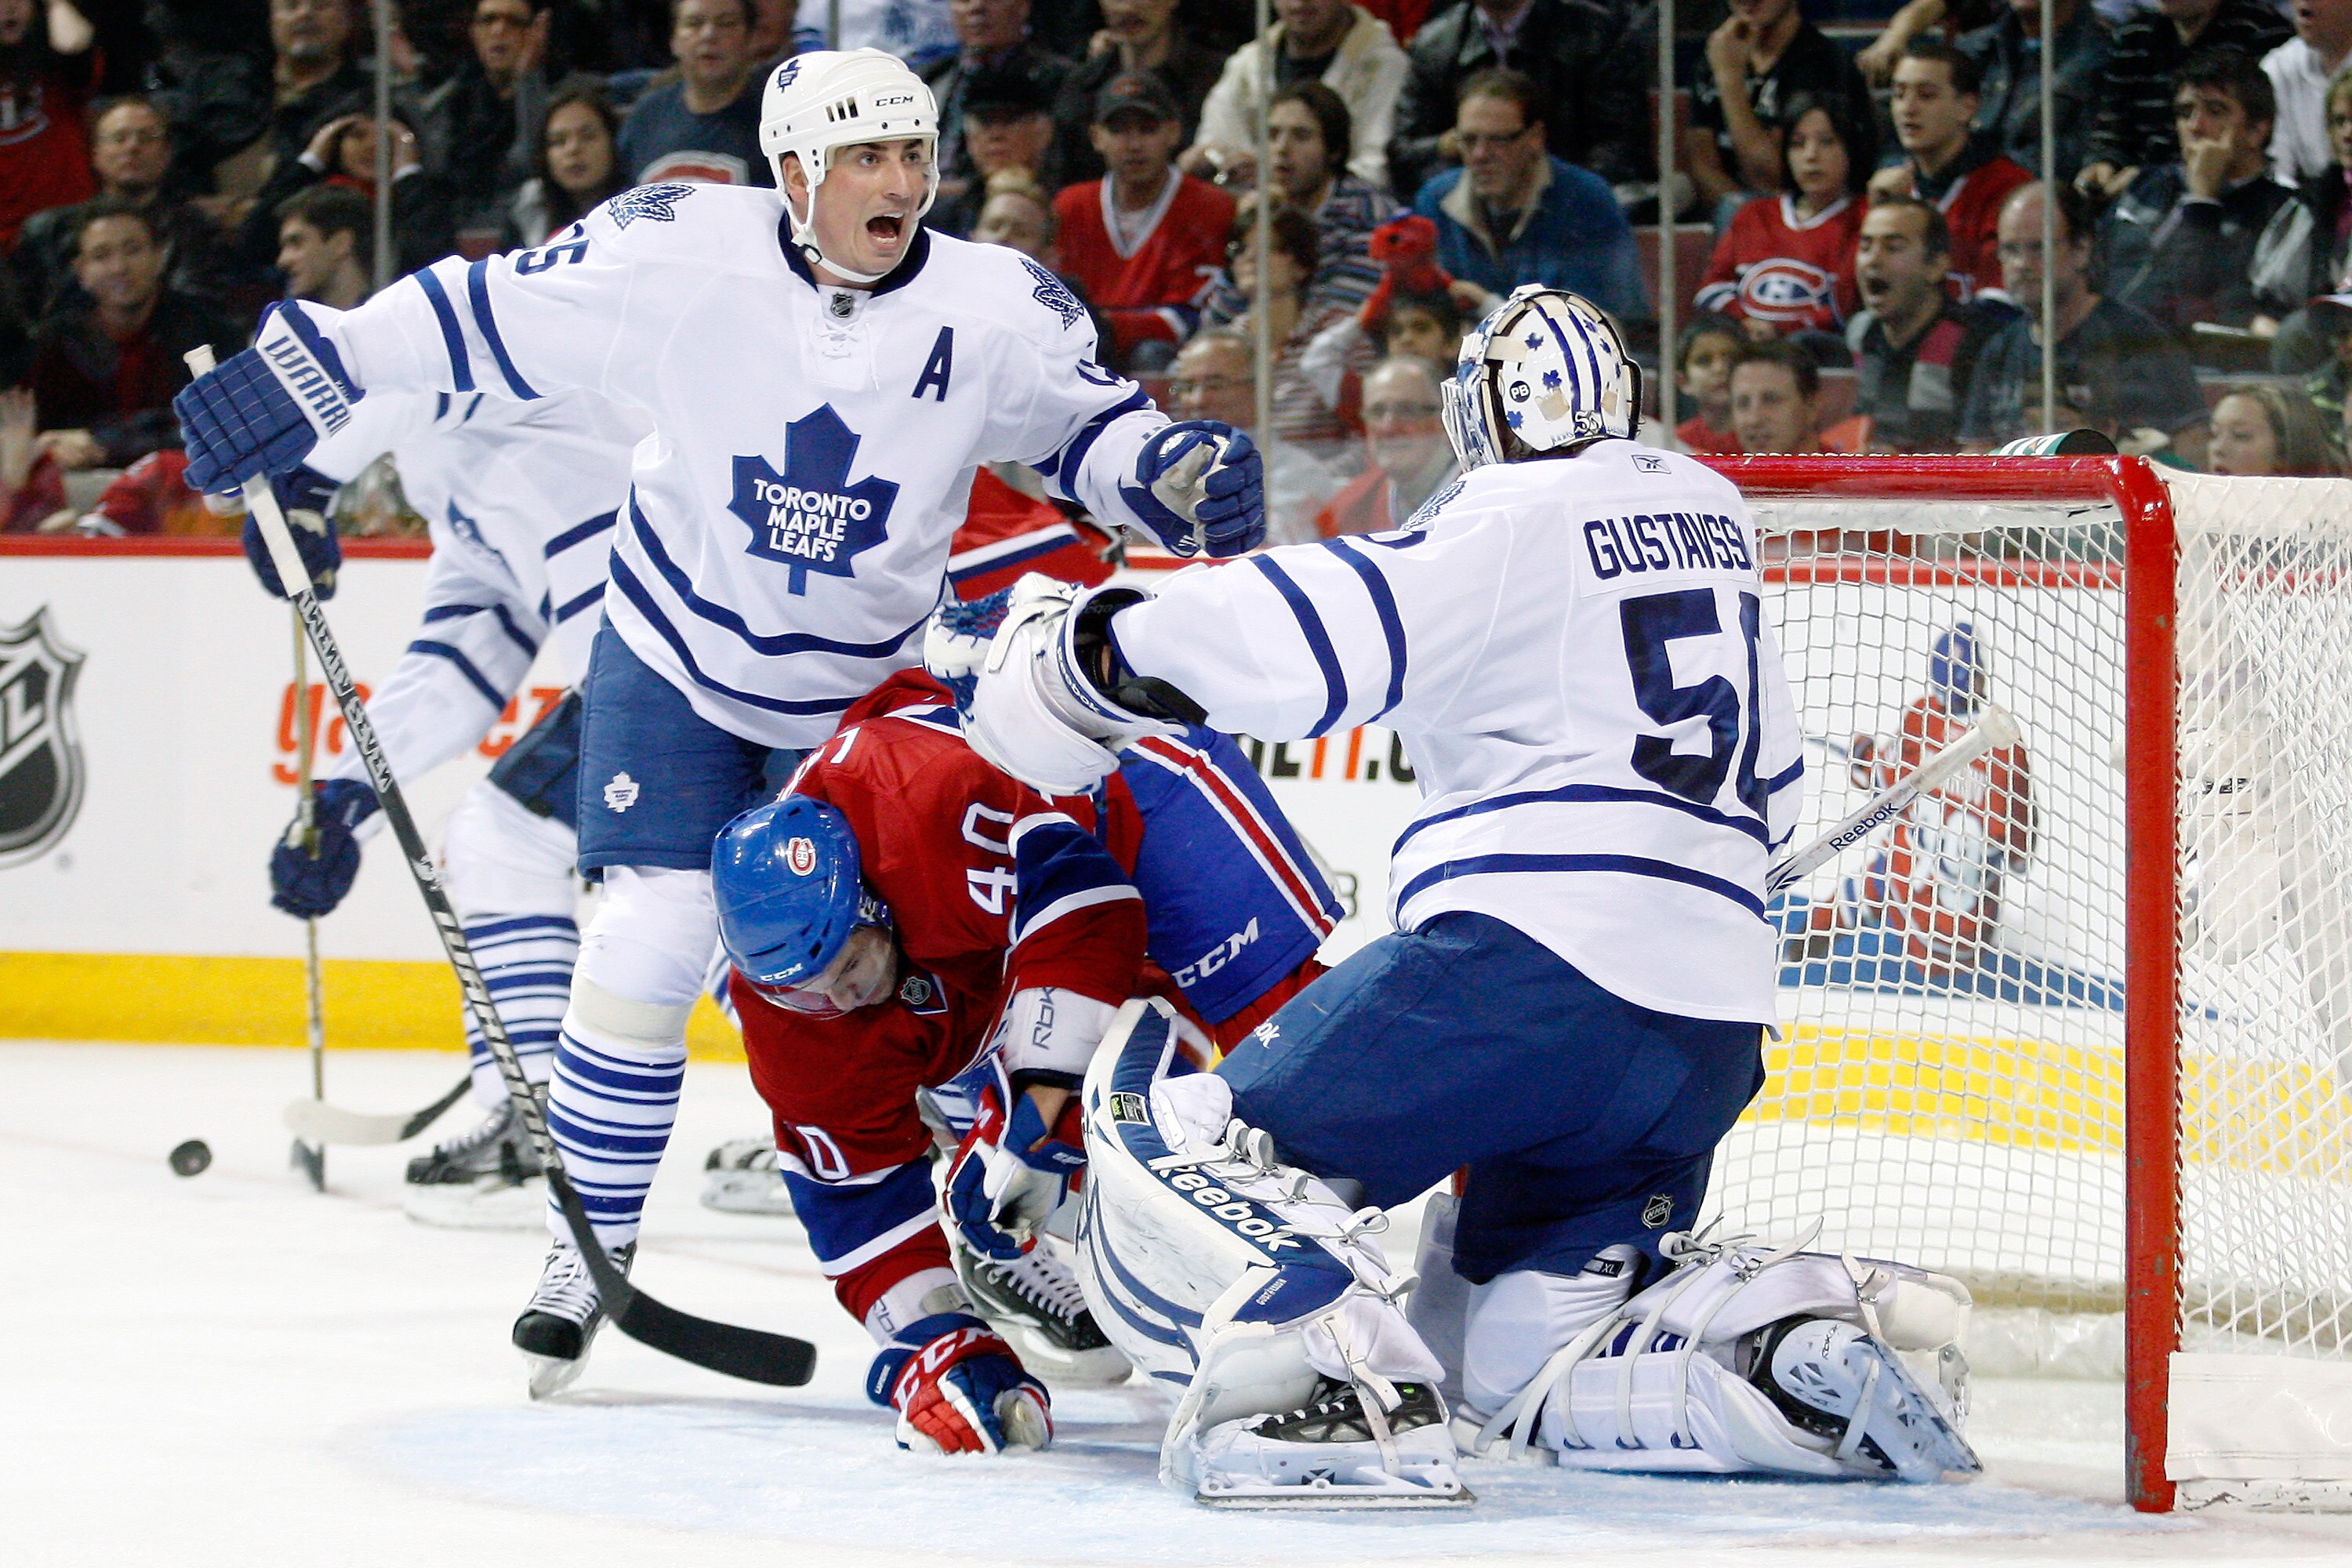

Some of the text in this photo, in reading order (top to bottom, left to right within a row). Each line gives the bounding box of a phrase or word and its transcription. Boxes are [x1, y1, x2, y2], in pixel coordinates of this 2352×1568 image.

[875, 95, 913, 107] CCM
[911, 325, 954, 402] A
[1510, 384, 1530, 398] PB
[753, 478, 872, 521] TORONTO
[767, 506, 848, 542] MAPLE
[769, 528, 838, 562] LEAFS
[1583, 512, 1751, 580] GUSTAVSS
[343, 695, 392, 793] SEVEN
[1829, 802, 1900, 852] Reebok
[960, 801, 1018, 916] 40
[760, 962, 804, 982] CCM
[1171, 916, 1259, 989] CCM
[792, 1124, 851, 1180] 0
[1601, 1262, 1615, 1275] XL
[894, 1327, 1004, 1413] CCM
